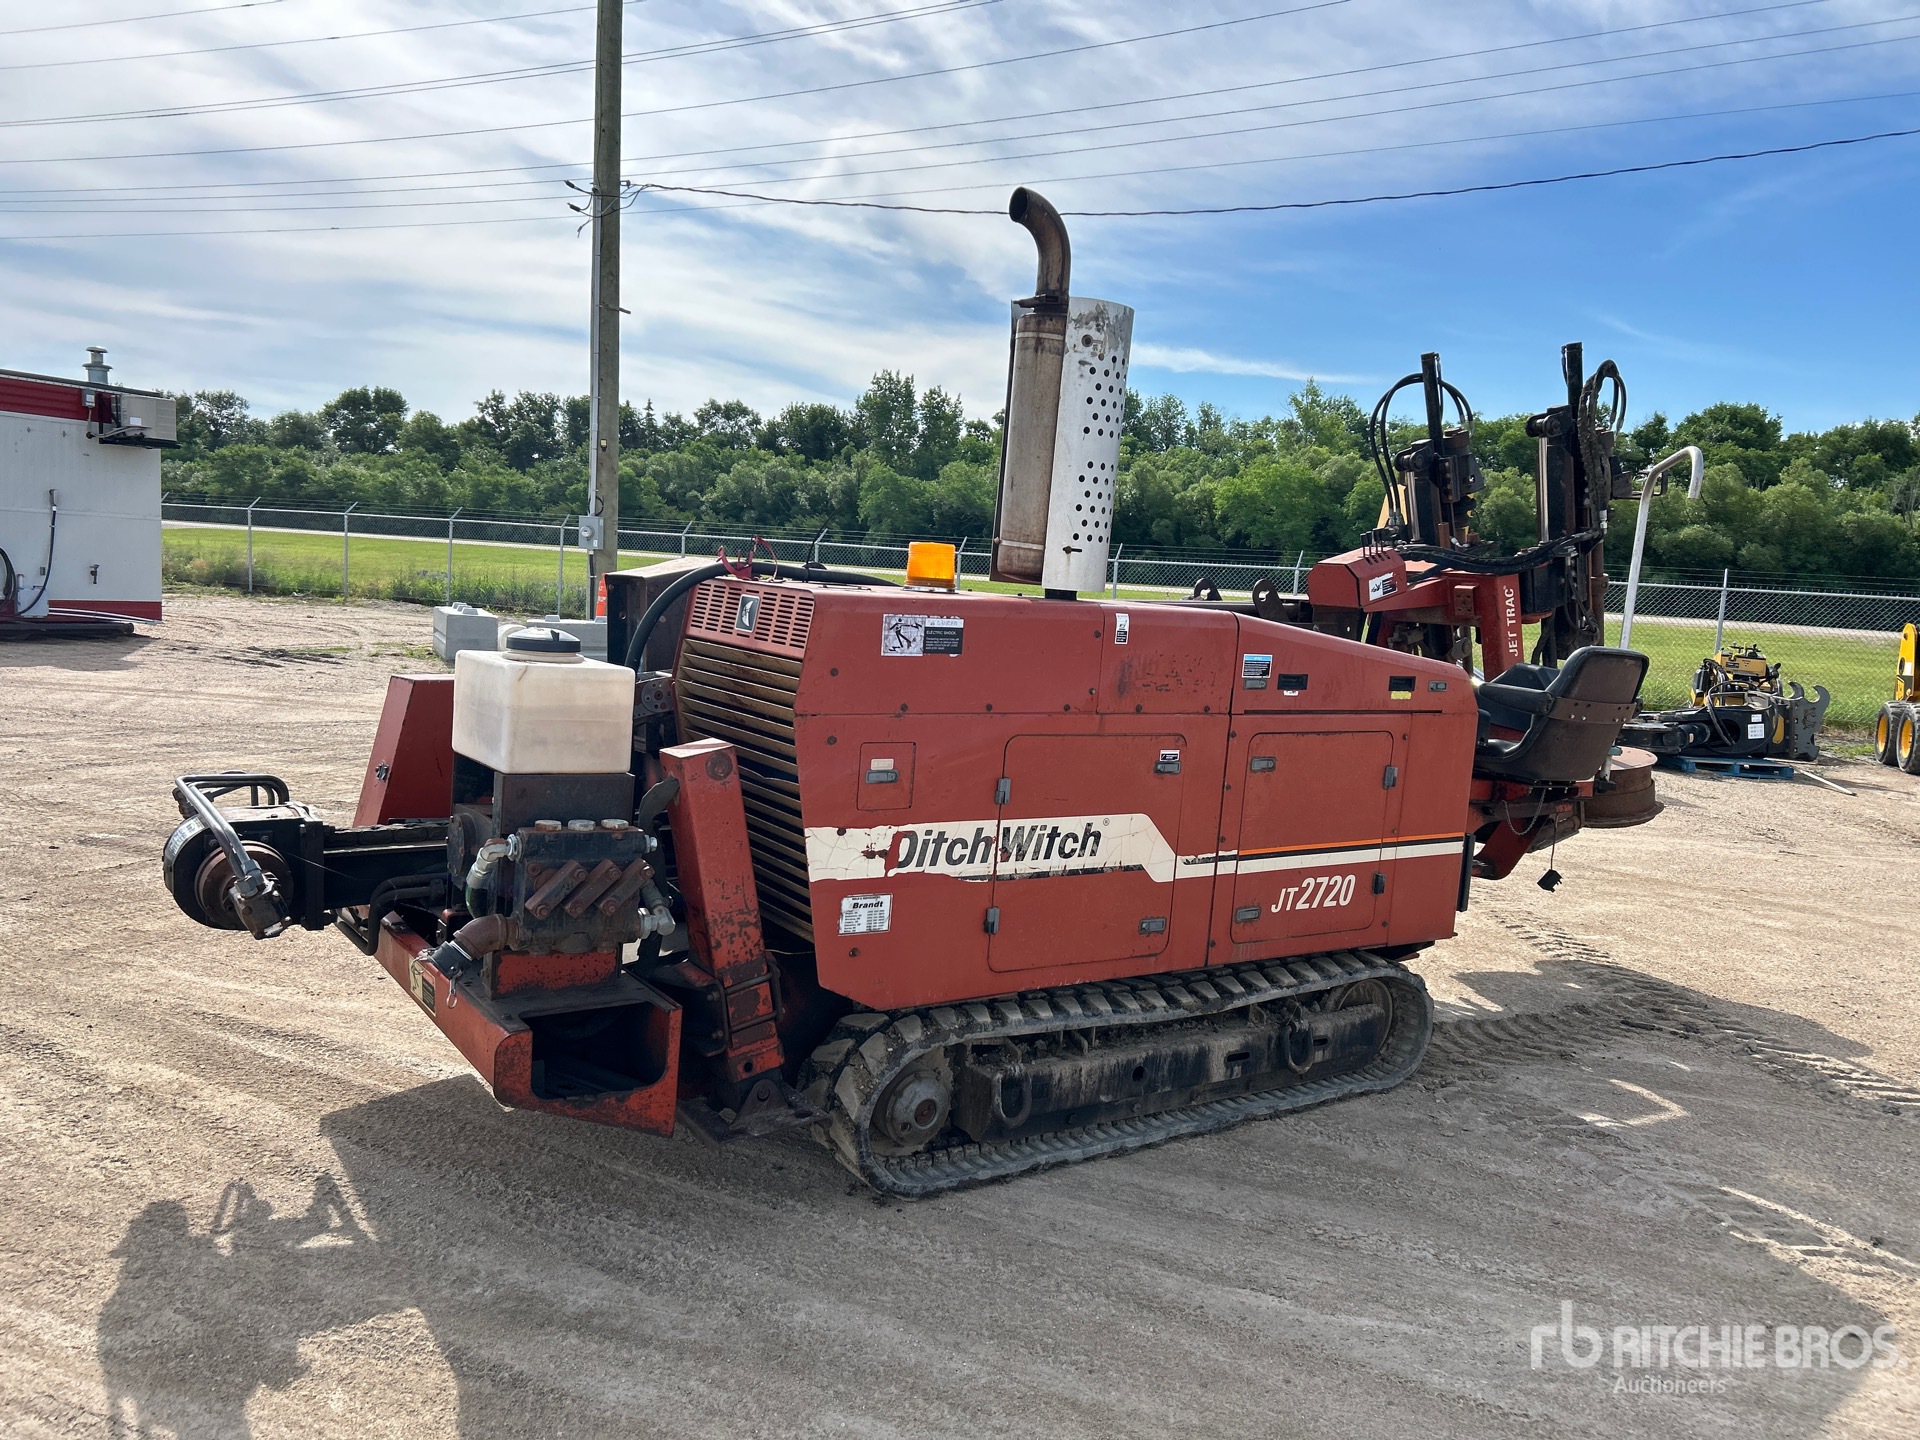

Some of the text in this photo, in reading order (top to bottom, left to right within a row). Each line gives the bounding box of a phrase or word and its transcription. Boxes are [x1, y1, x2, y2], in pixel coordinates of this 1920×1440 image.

[1504, 588, 1519, 657] JET TRAC
[896, 822, 1102, 869] Ditch Witch
[852, 900, 884, 909] Brandt
[1271, 874, 1356, 913] JT2720
